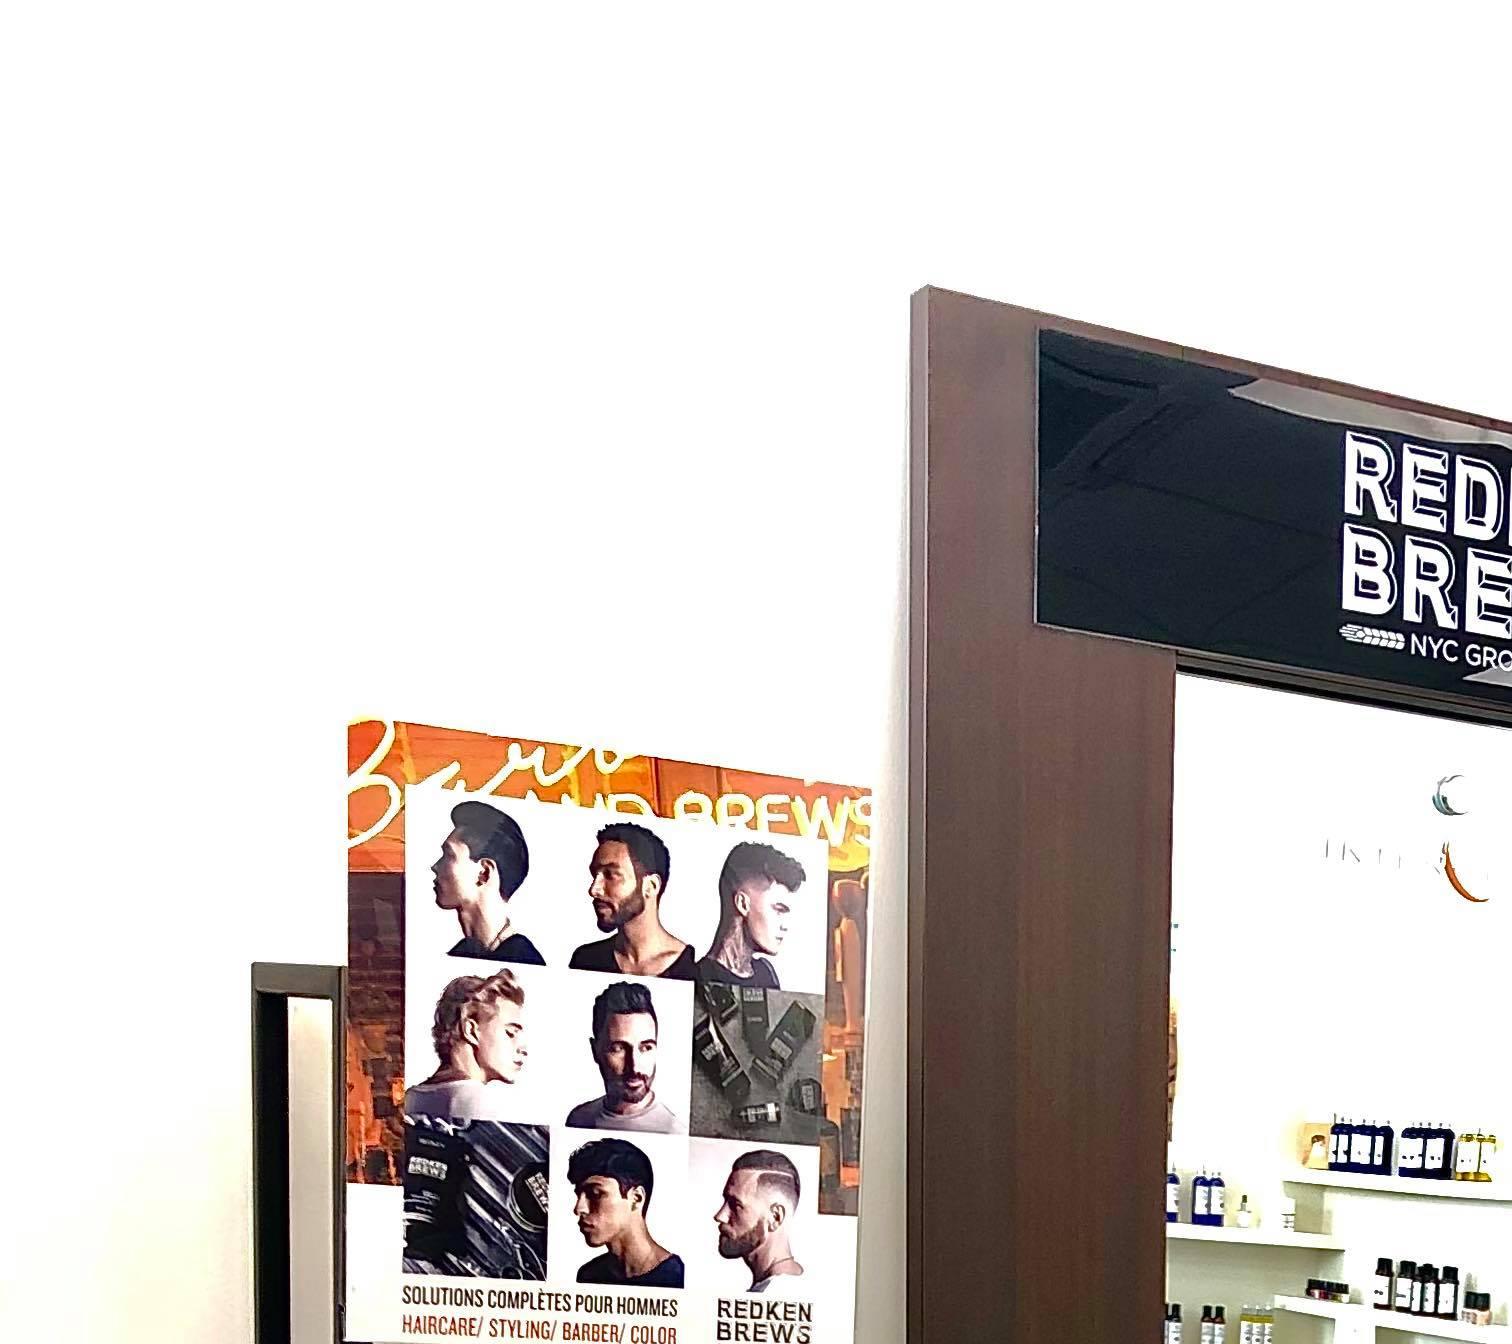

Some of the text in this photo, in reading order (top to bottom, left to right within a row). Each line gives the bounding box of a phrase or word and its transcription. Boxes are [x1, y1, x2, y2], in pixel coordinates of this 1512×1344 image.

[1410, 633, 1460, 664] NYC
[402, 1285, 679, 1318] SOLUTIONS COMPLÈTES POUR HOMMES
[717, 1297, 813, 1323] REDKEN
[402, 1314, 484, 1338] HAIRCARE/
[488, 1317, 558, 1342] STYLING/
[562, 1322, 626, 1344] BARBER/
[716, 1319, 812, 1344] BREWS
